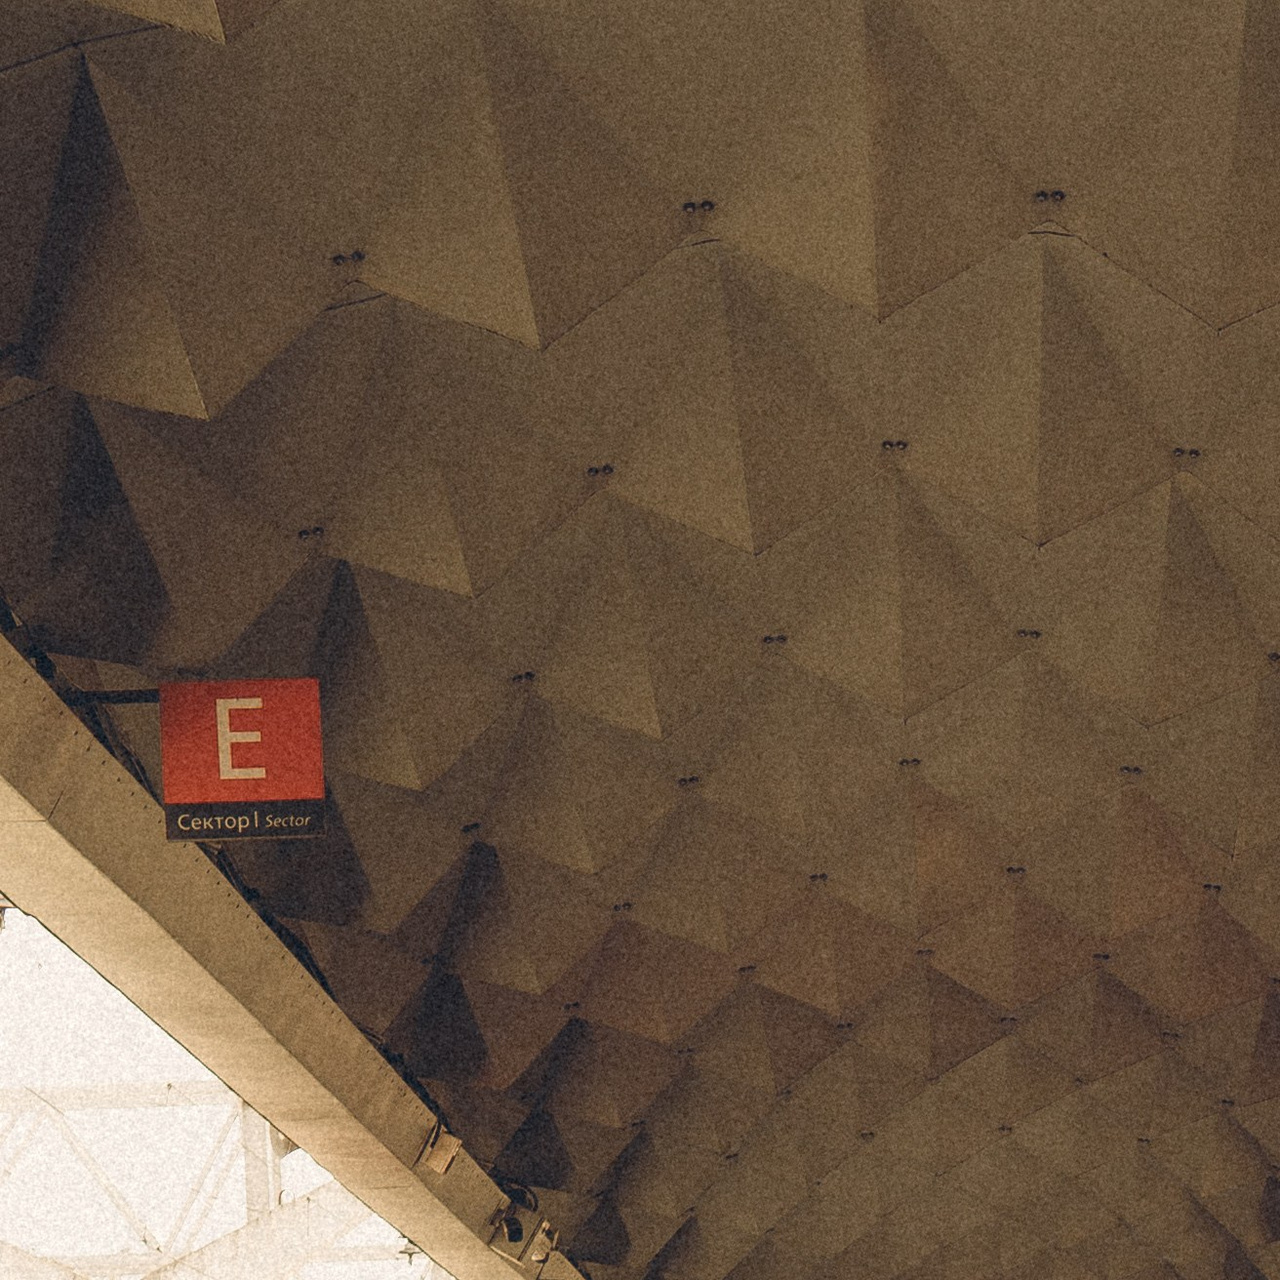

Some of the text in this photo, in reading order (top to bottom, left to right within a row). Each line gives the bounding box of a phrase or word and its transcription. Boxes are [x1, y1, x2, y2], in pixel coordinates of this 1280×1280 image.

[215, 697, 267, 780] E
[177, 813, 311, 833] Сектор Sector
